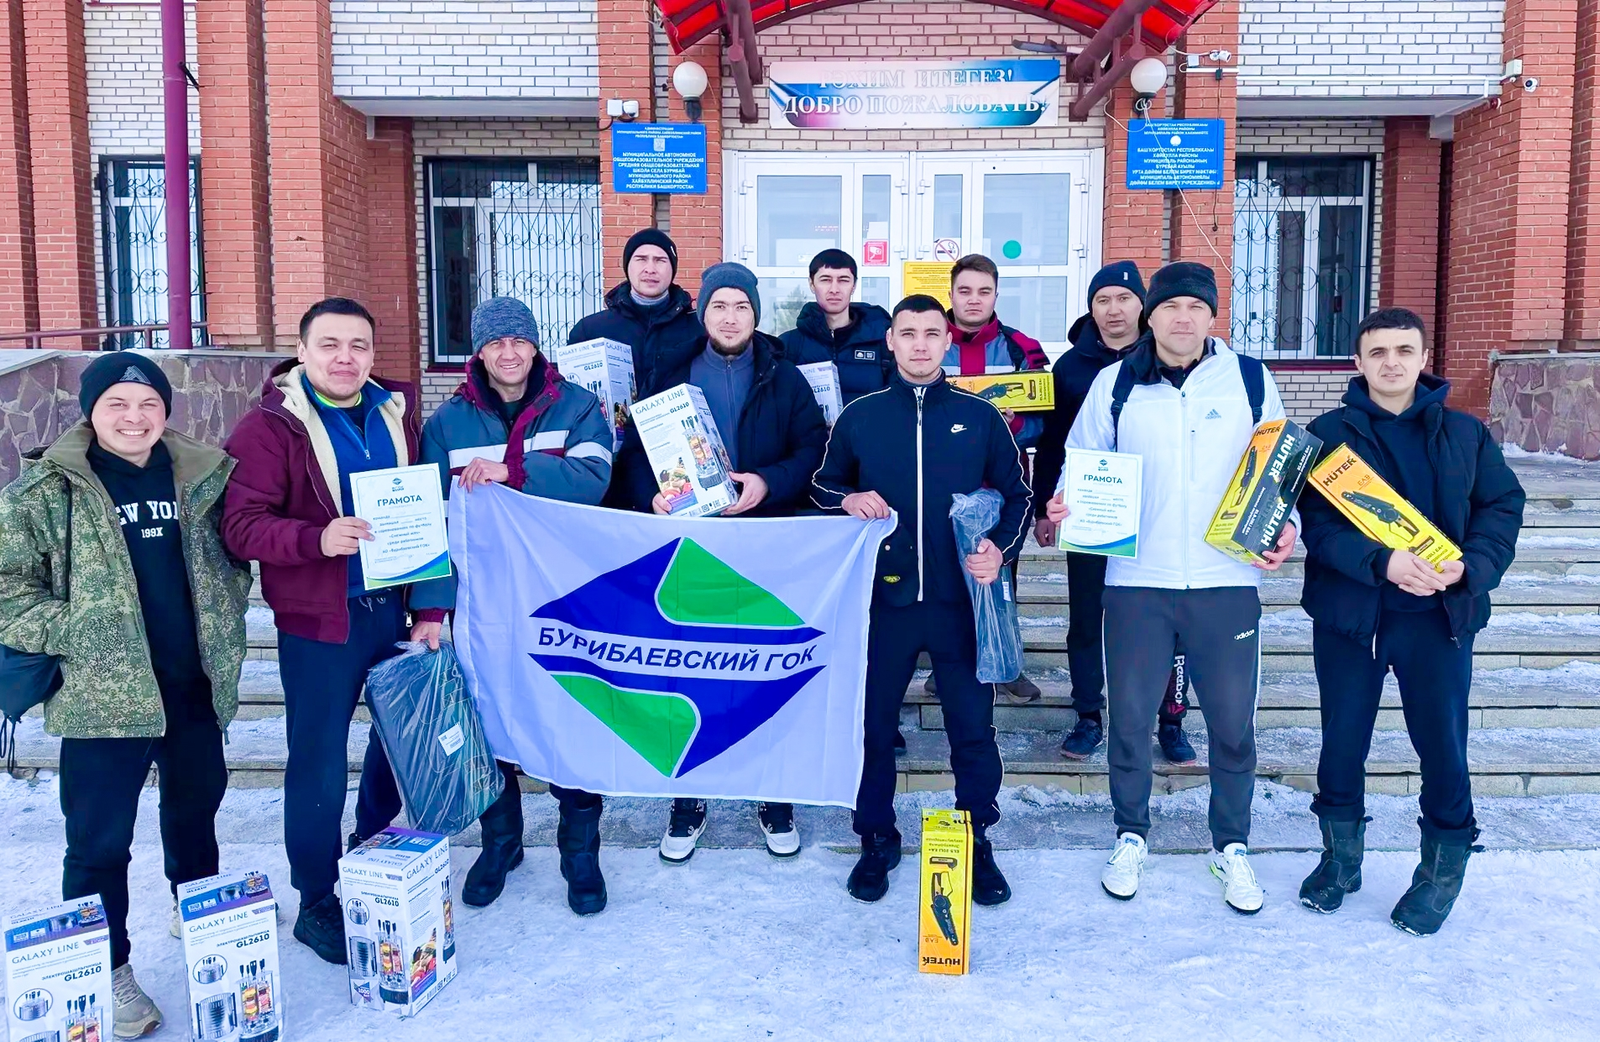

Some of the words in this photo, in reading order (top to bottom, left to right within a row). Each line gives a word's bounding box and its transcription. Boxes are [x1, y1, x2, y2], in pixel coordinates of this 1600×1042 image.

[915, 69, 1013, 88] ИТЕГЕЗ!
[782, 95, 862, 116] ДОБРО
[866, 94, 1048, 115] ПОЖАЛОВАТЬ!
[635, 396, 666, 414] GALAXY
[667, 389, 685, 401] LINE
[670, 402, 690, 414] GL2610
[1084, 474, 1122, 484] ГРАМОТА
[377, 494, 422, 507] ГРАМОТА
[114, 502, 138, 526] EW
[146, 501, 178, 520] YO
[1260, 500, 1288, 547] HÜTER
[141, 527, 163, 538] 199X
[1234, 629, 1255, 640] adidas
[538, 626, 759, 671] БУРИБАЕВСКИЙ
[764, 644, 817, 671] ГОК
[406, 854, 433, 880] GALAXY
[435, 843, 449, 859] LINE
[342, 866, 367, 876] GALAXY
[369, 870, 384, 879] LINE
[374, 897, 400, 907] GL2610
[189, 917, 226, 933] GALAXY
[229, 911, 248, 923] LINE
[236, 933, 270, 949] GL2610
[12, 948, 54, 965] GALAXY
[57, 941, 79, 953] LINE
[922, 956, 960, 966] HÜTER
[64, 965, 101, 982] GL2610
